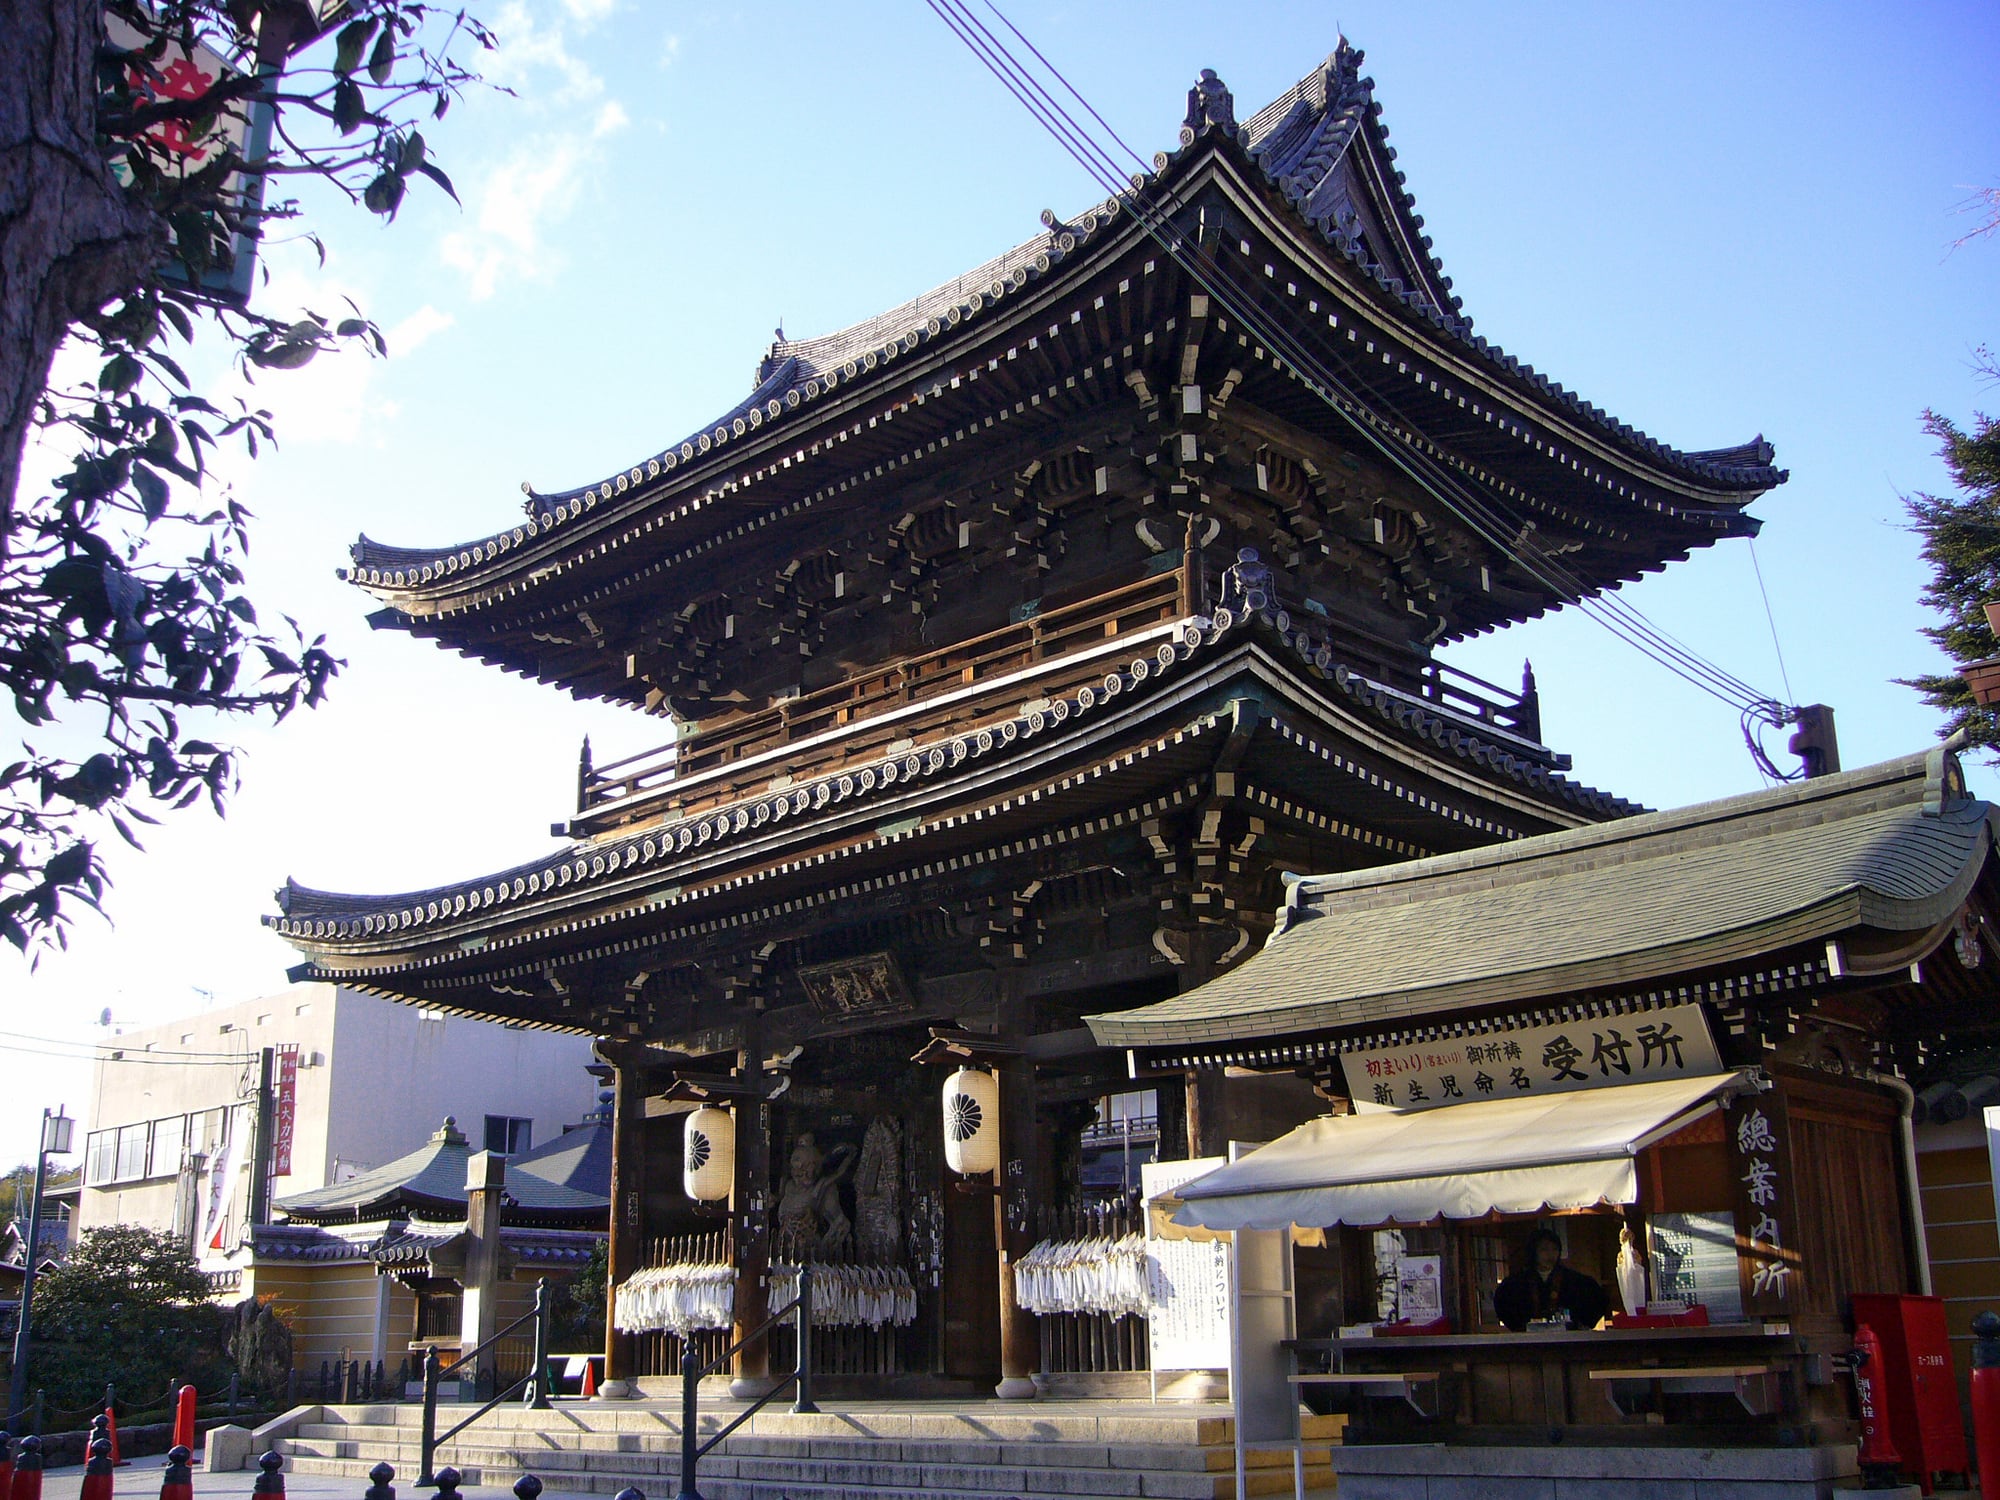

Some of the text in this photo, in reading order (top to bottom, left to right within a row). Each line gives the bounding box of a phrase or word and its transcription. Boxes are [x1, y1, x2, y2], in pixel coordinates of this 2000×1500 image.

[1541, 1022, 1684, 1082] 受付所
[1373, 1066, 1531, 1105] 新生児命名
[279, 1090, 293, 1169] 五大力不動
